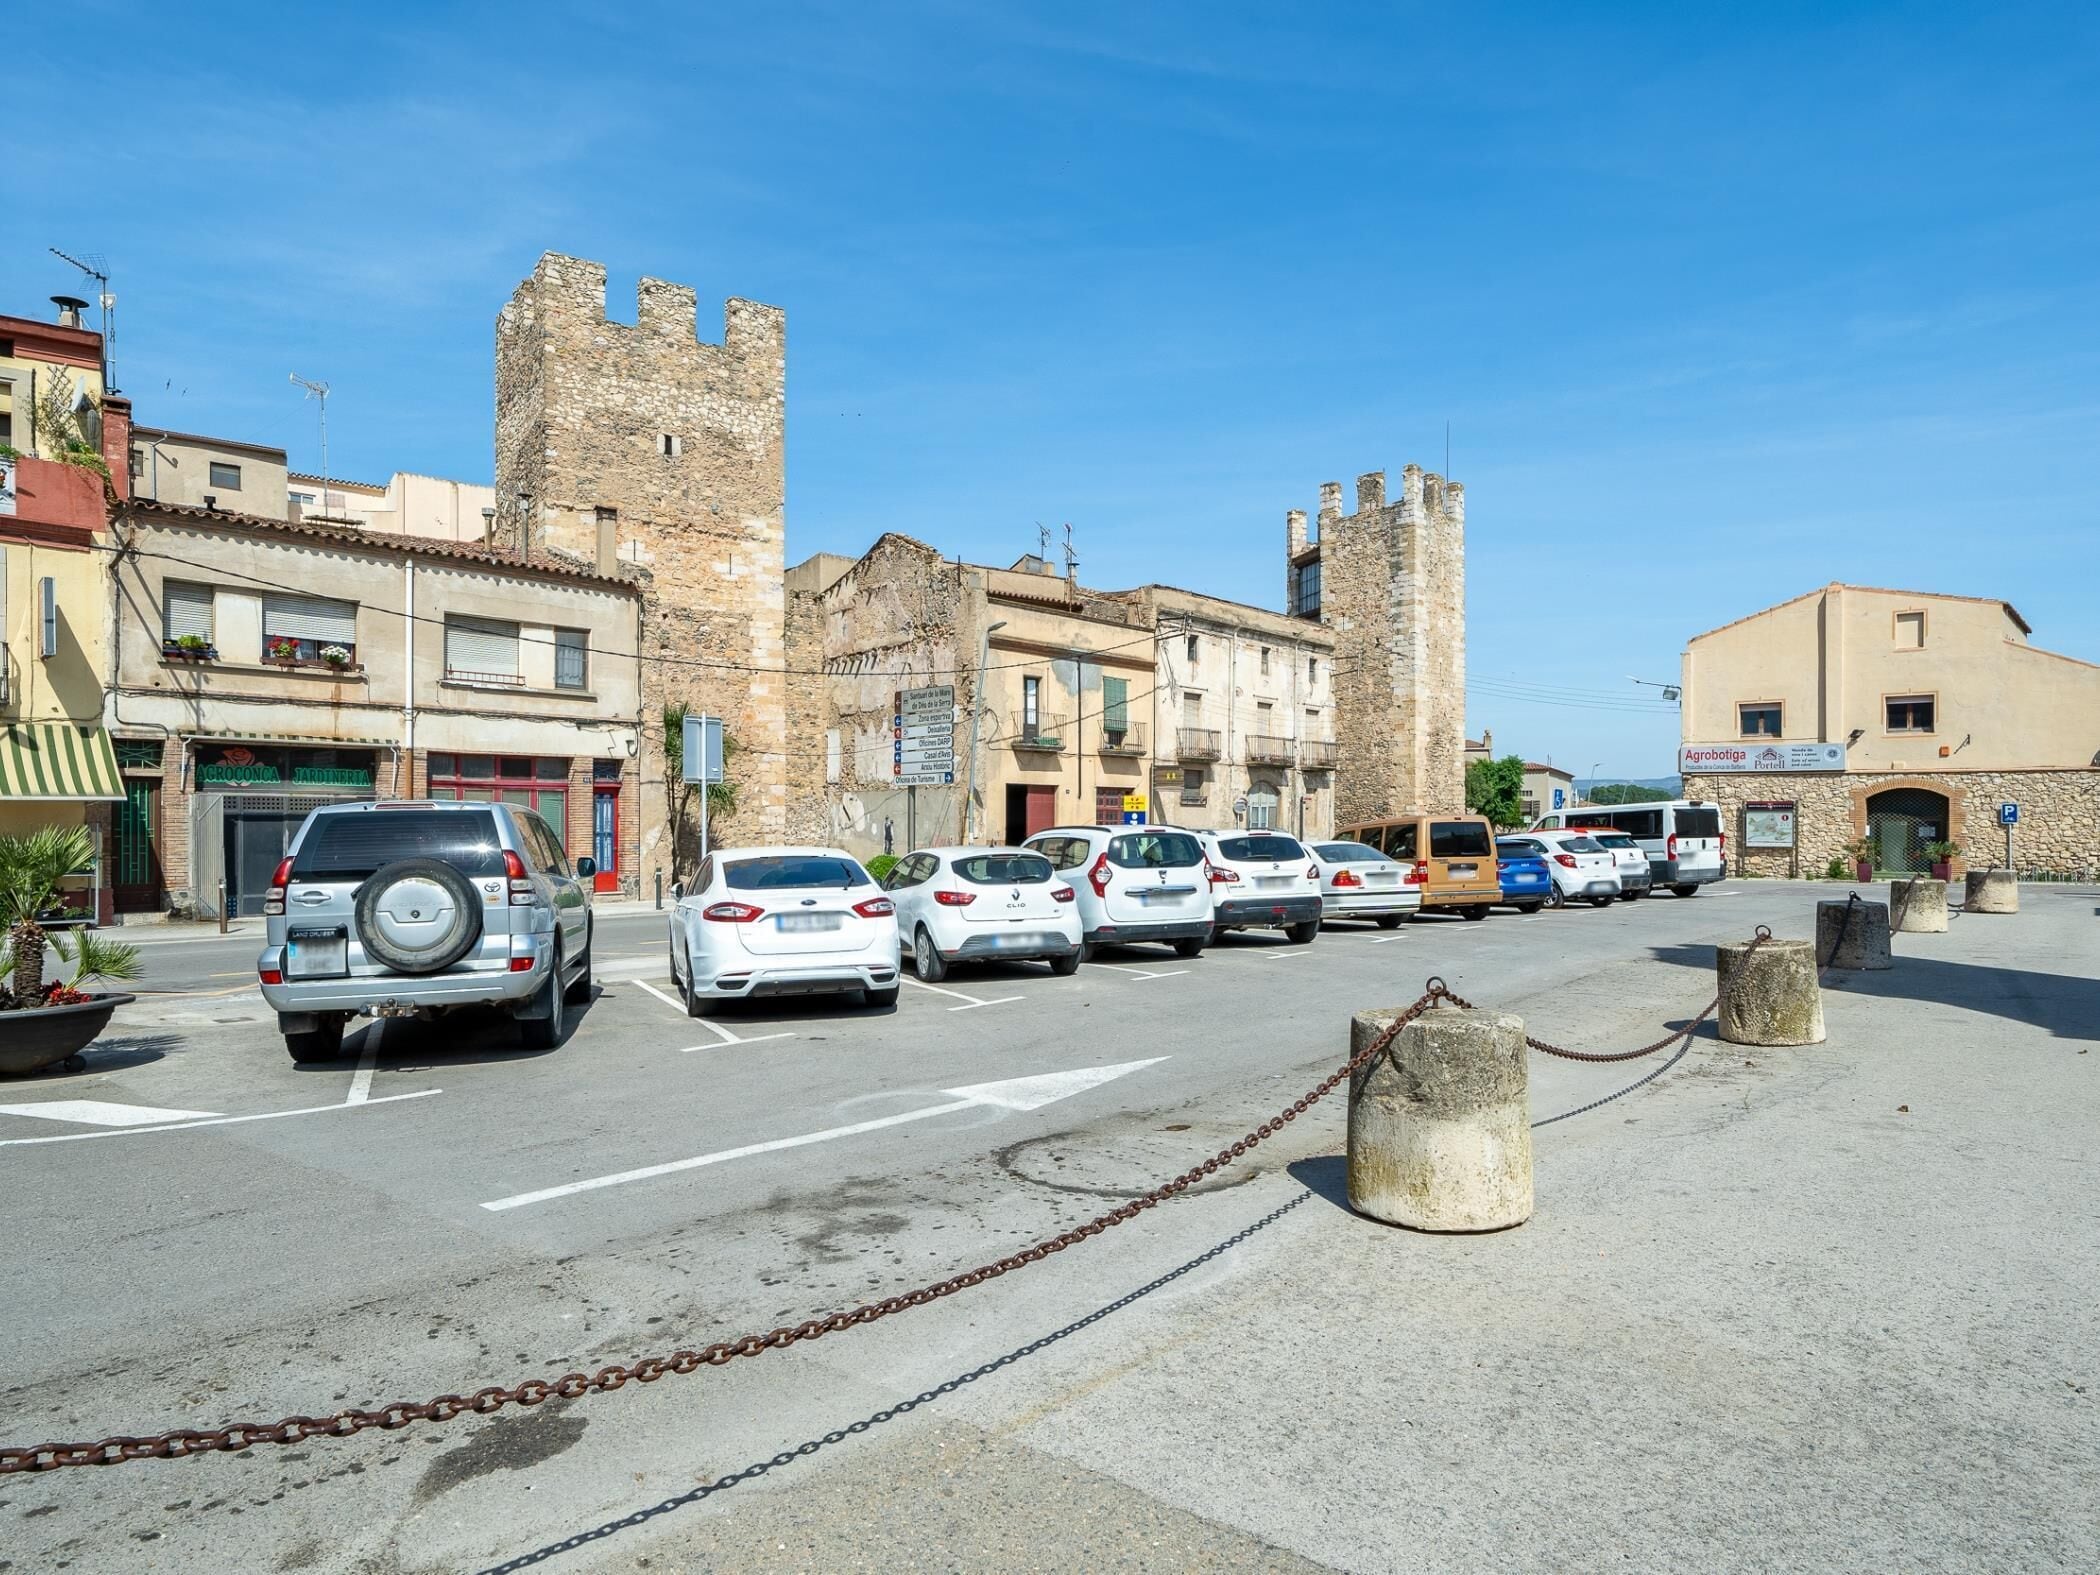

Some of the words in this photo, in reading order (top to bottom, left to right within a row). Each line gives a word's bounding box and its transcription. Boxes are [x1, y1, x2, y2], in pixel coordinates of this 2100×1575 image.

[928, 690, 933, 698] de
[912, 701, 917, 709] de
[928, 700, 933, 708] de
[918, 714, 929, 723] Zona
[1685, 748, 1746, 763] Agrobotiga
[1754, 760, 1785, 770] Portell
[197, 764, 280, 784] AGROCONCA
[293, 767, 371, 787] JARDINERIA
[911, 775, 917, 783] de
[2005, 805, 2015, 816] P
